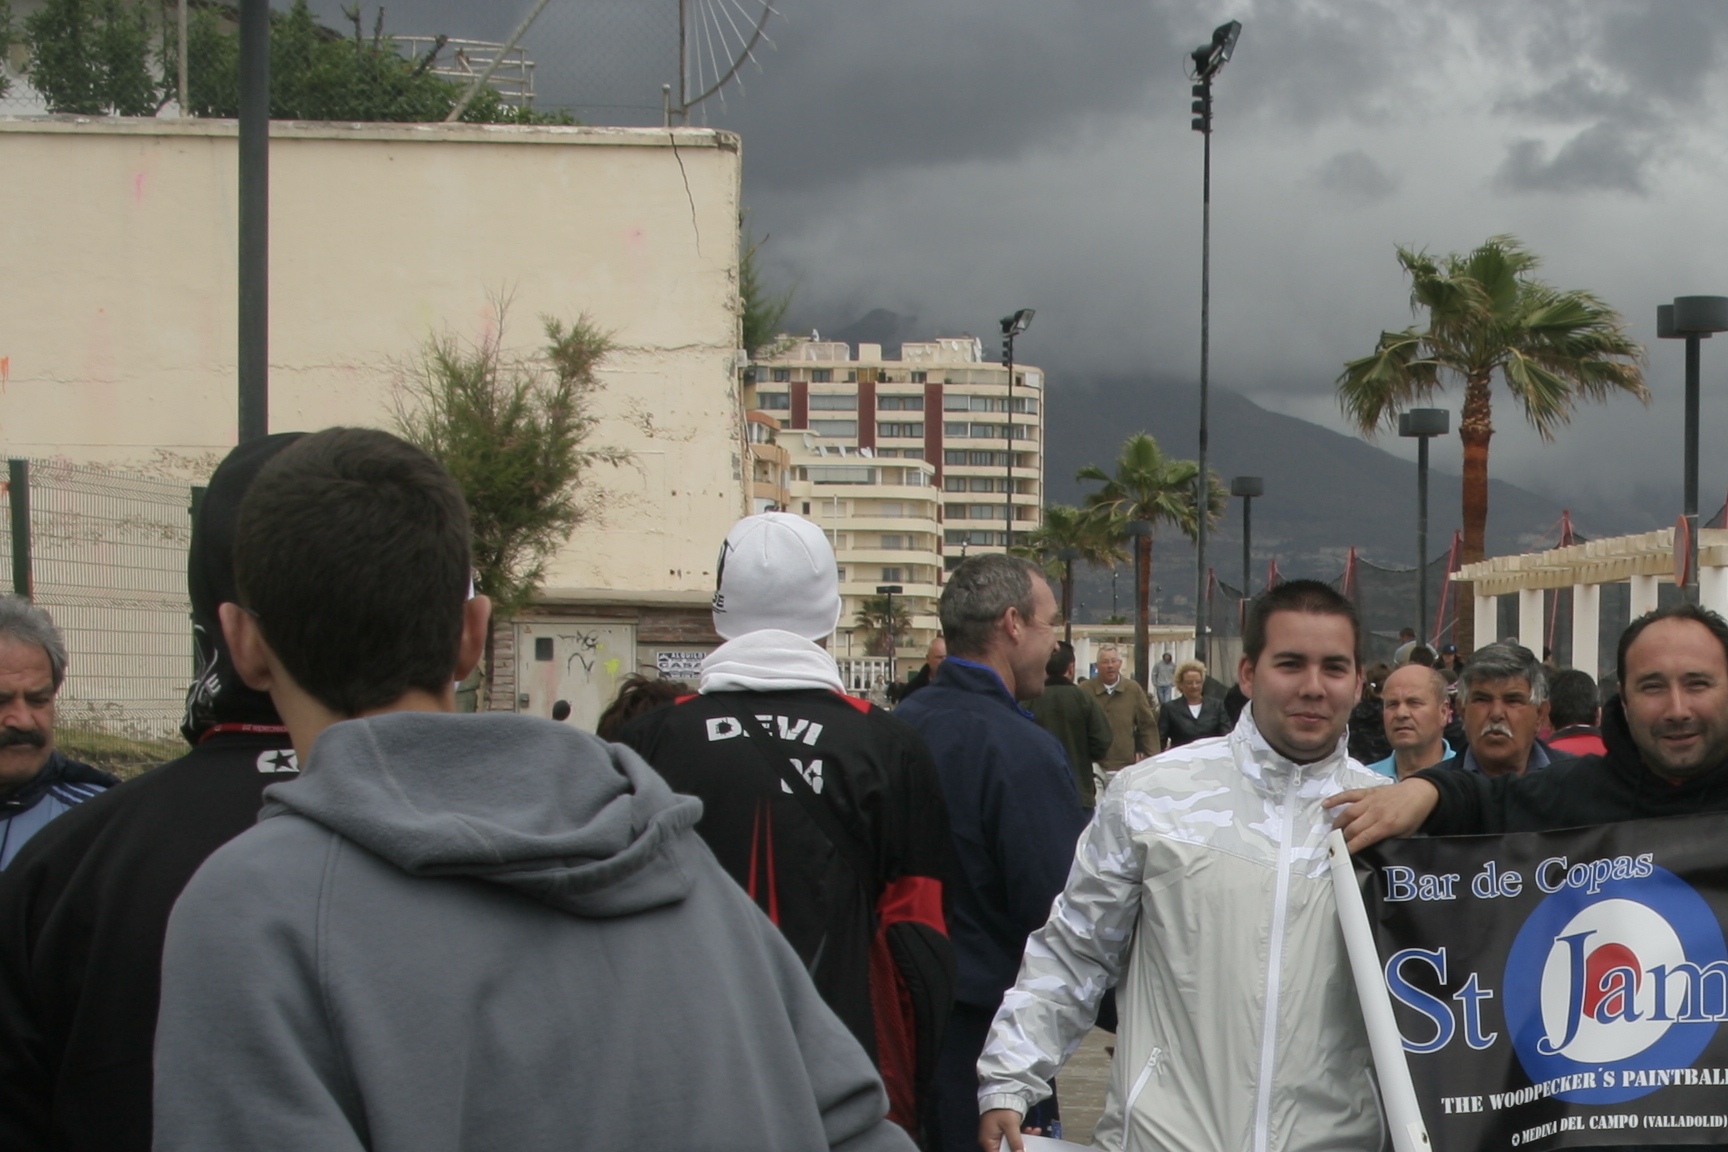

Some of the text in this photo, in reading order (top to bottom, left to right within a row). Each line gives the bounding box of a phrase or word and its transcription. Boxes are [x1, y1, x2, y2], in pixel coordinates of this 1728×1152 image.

[1383, 852, 1654, 902] Bar de Copas
[1384, 947, 1498, 1054] St
[1441, 1095, 1483, 1114] THE
[1522, 1114, 1728, 1144] MEDINA DEL CAMPO (VALLADOLID)
